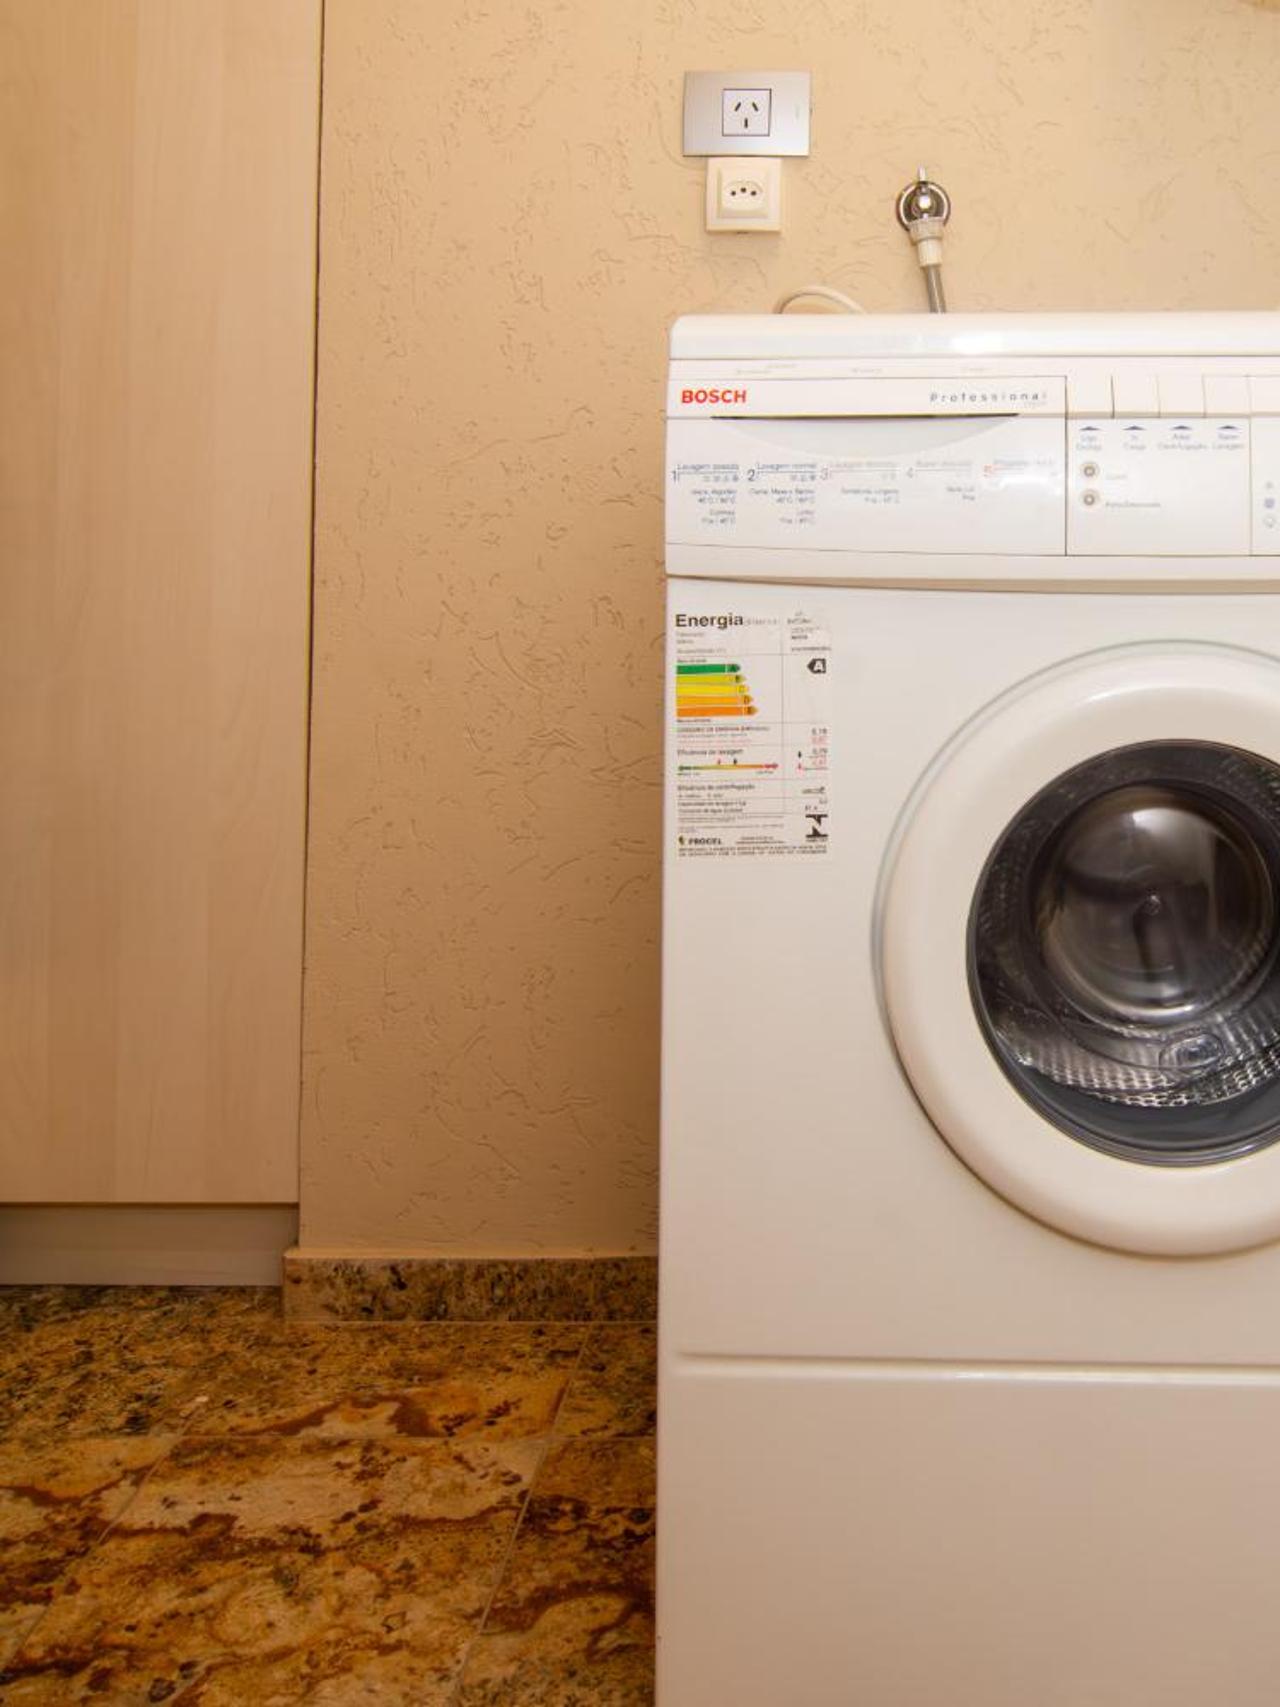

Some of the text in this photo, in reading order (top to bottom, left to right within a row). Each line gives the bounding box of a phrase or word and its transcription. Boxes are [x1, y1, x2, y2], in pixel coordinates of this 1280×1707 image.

[681, 389, 747, 403] BOSCH
[930, 391, 1048, 403] Professional
[747, 469, 755, 482] 2
[675, 612, 744, 630] Energia
